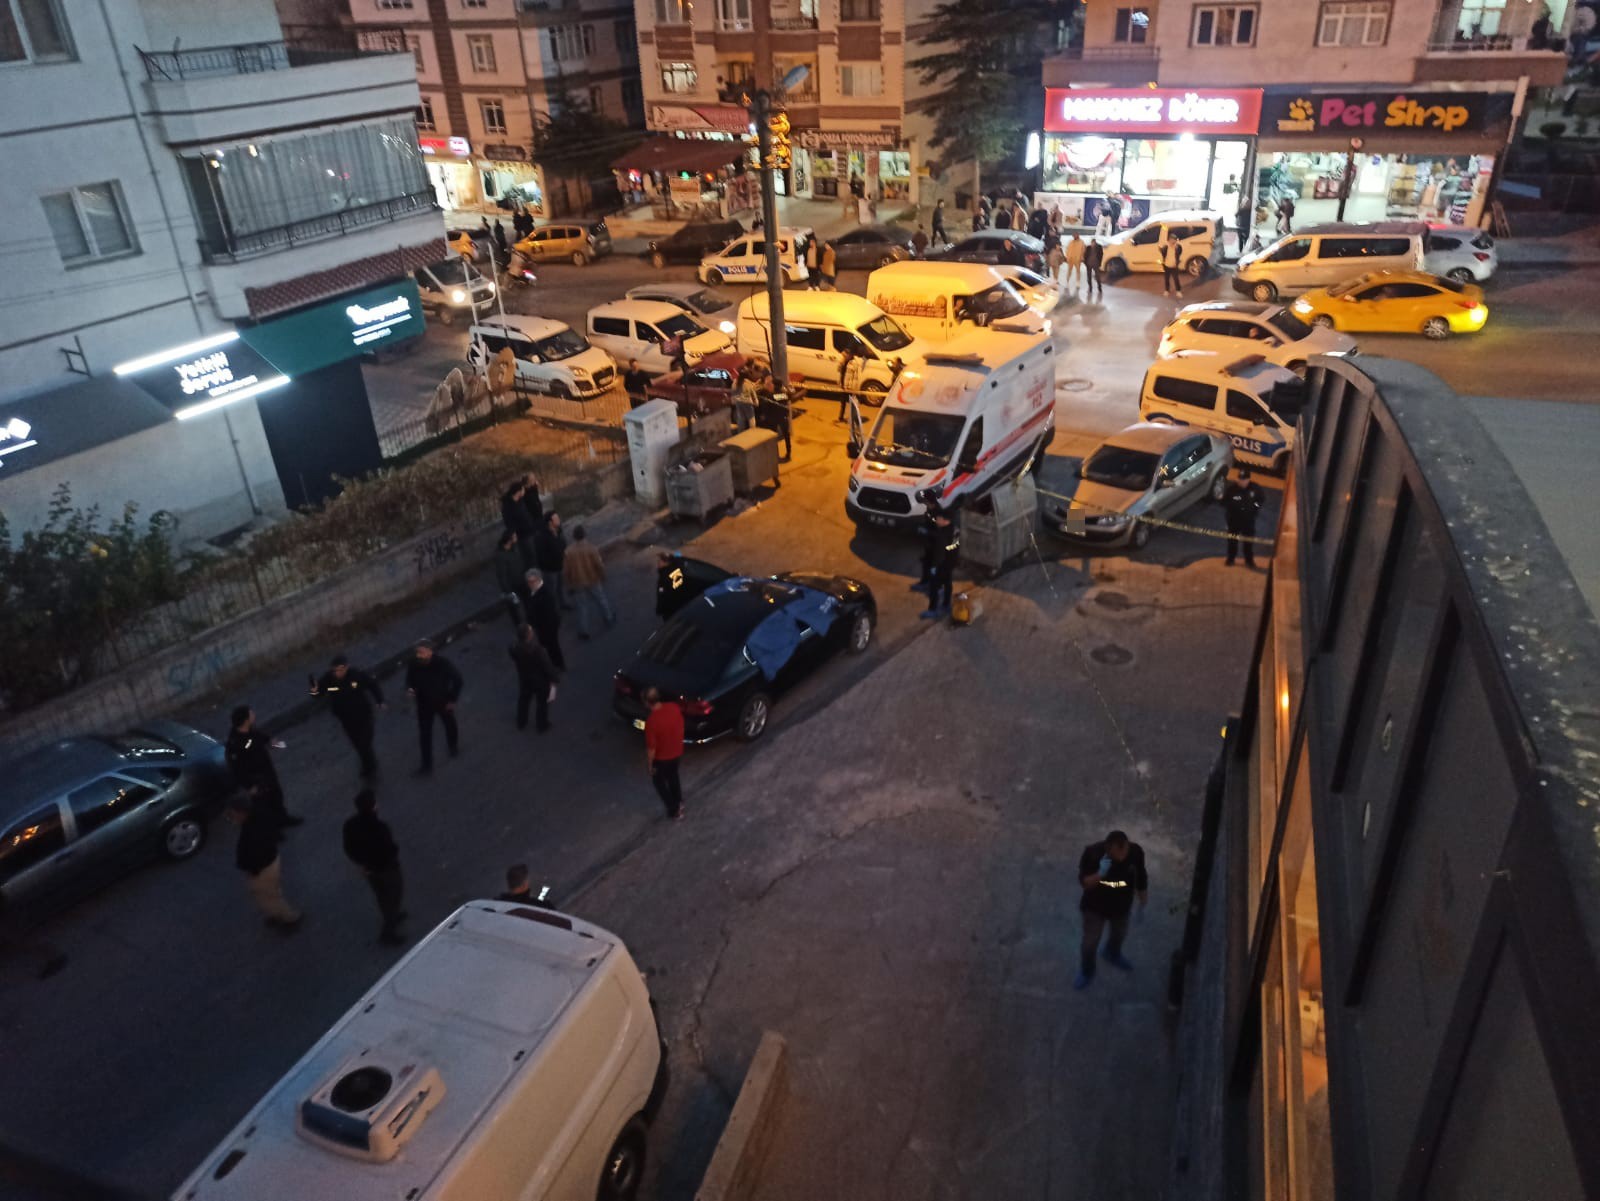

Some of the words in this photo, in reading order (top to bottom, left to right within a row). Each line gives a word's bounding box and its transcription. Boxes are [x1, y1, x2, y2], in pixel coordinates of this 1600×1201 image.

[1168, 92, 1240, 123] DÖNER
[1320, 98, 1377, 127] Pet
[1384, 98, 1469, 131] Shop
